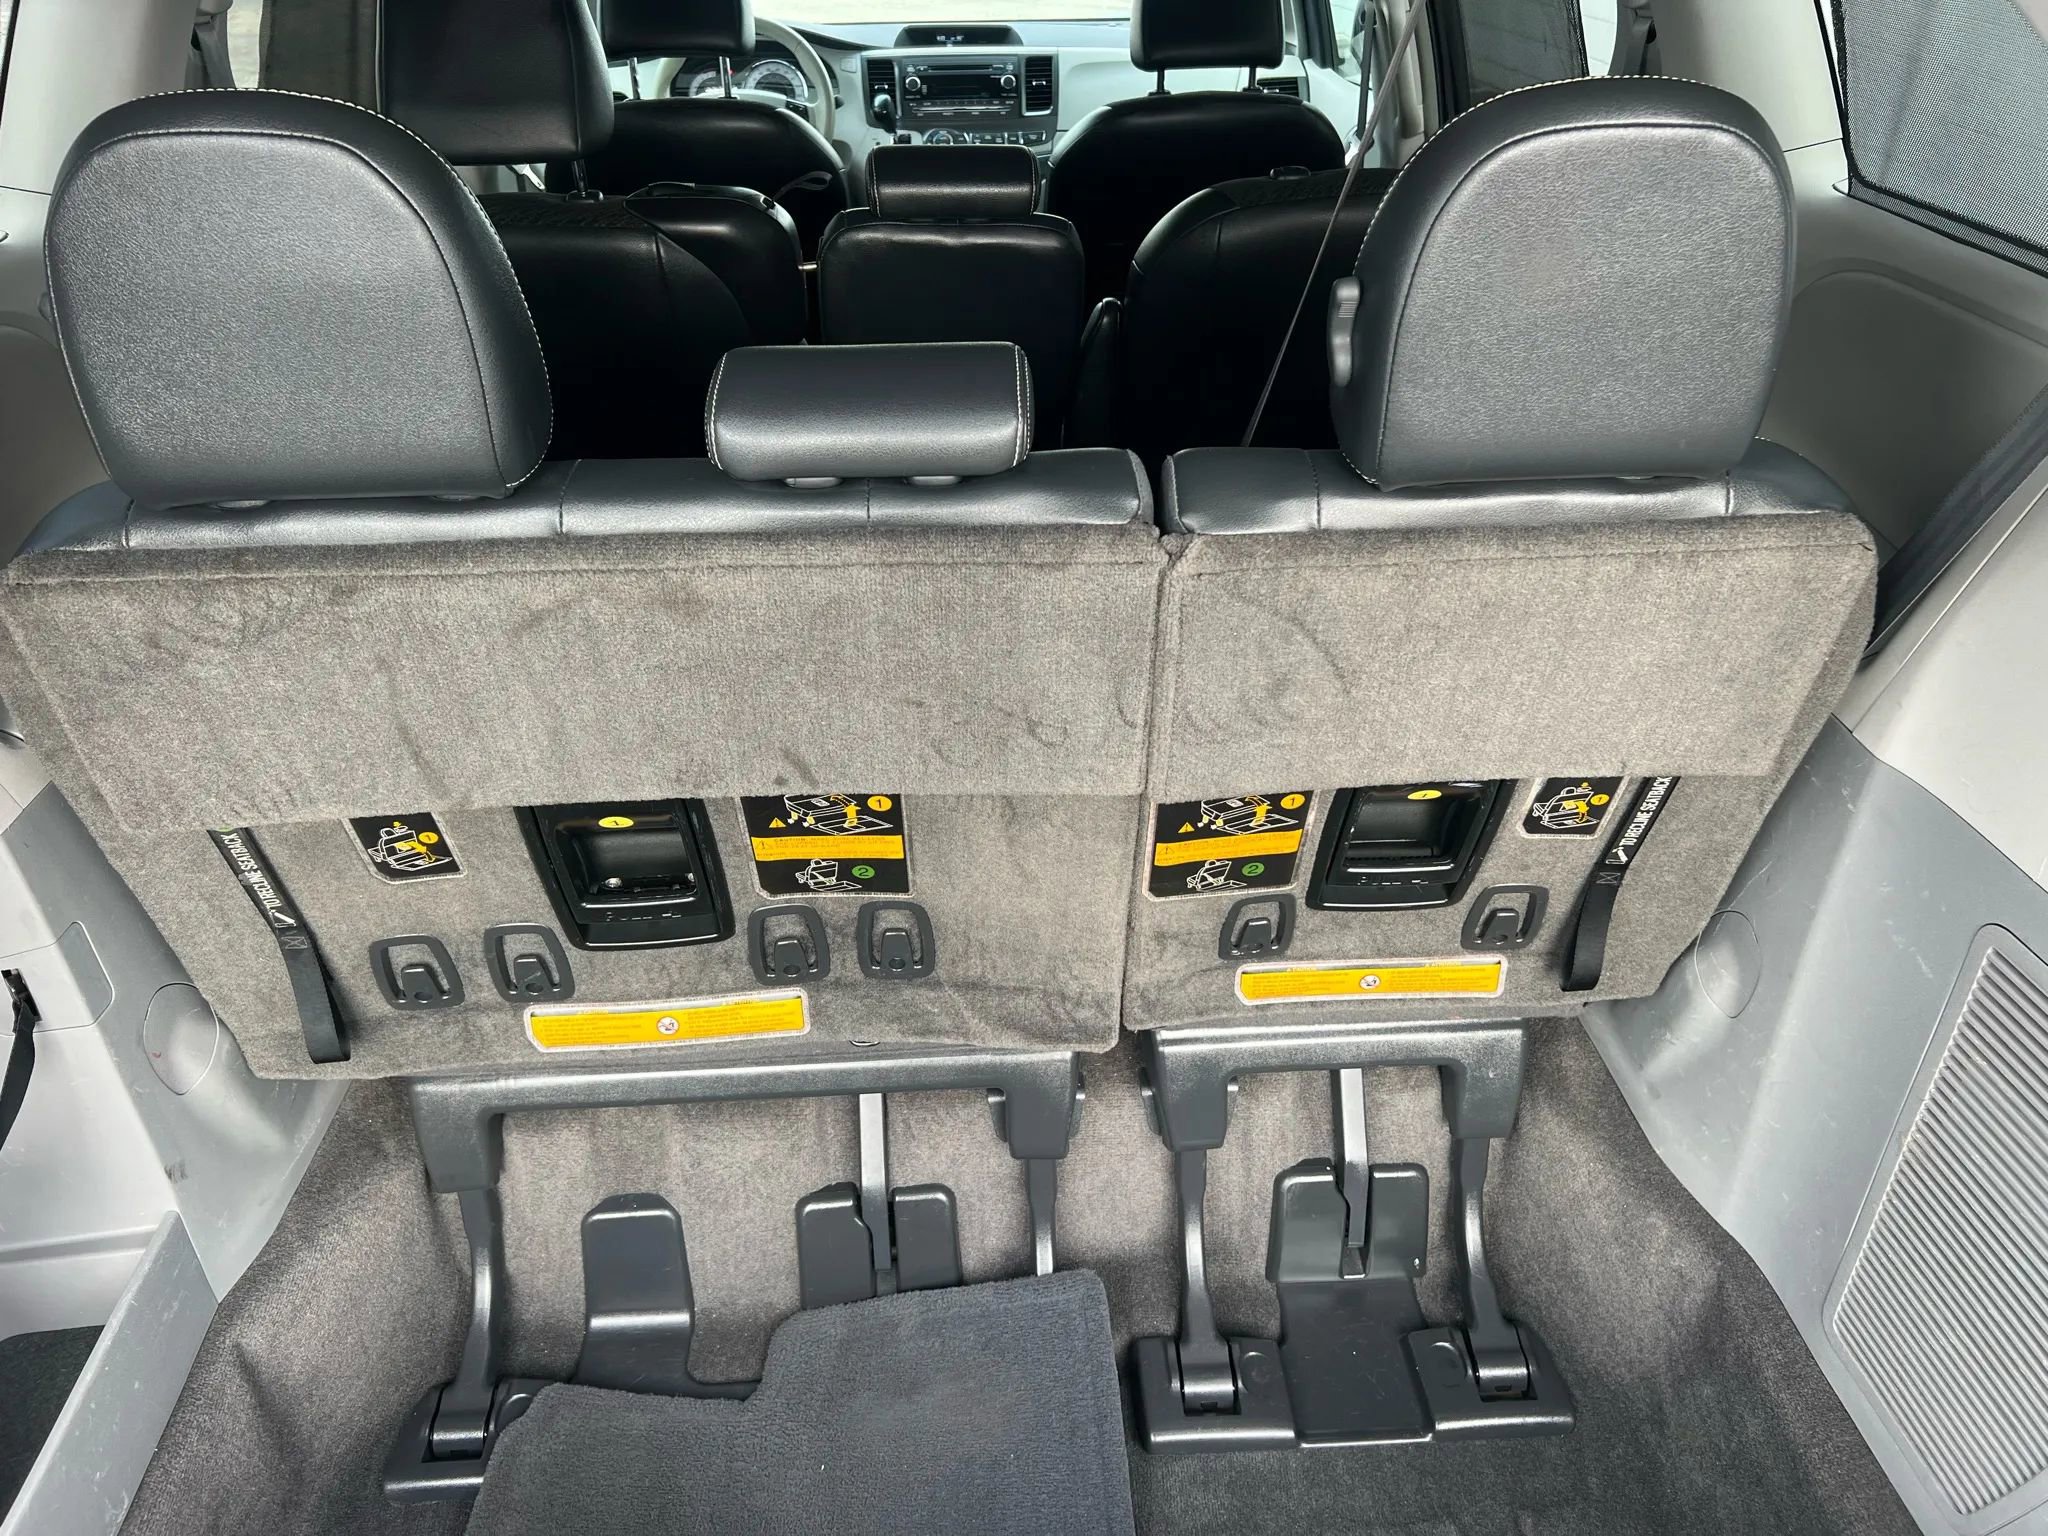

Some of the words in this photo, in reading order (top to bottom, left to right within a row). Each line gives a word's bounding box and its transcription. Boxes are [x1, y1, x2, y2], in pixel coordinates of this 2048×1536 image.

[1640, 777, 1673, 811] SEATBACK
[1625, 811, 1653, 839] RECLINE
[220, 832, 258, 870] SEATBACK
[1619, 837, 1638, 847] TO
[858, 866, 869, 877] 2
[1247, 864, 1259, 875] 2
[244, 869, 277, 900] RECLINE
[263, 899, 282, 910] TO
